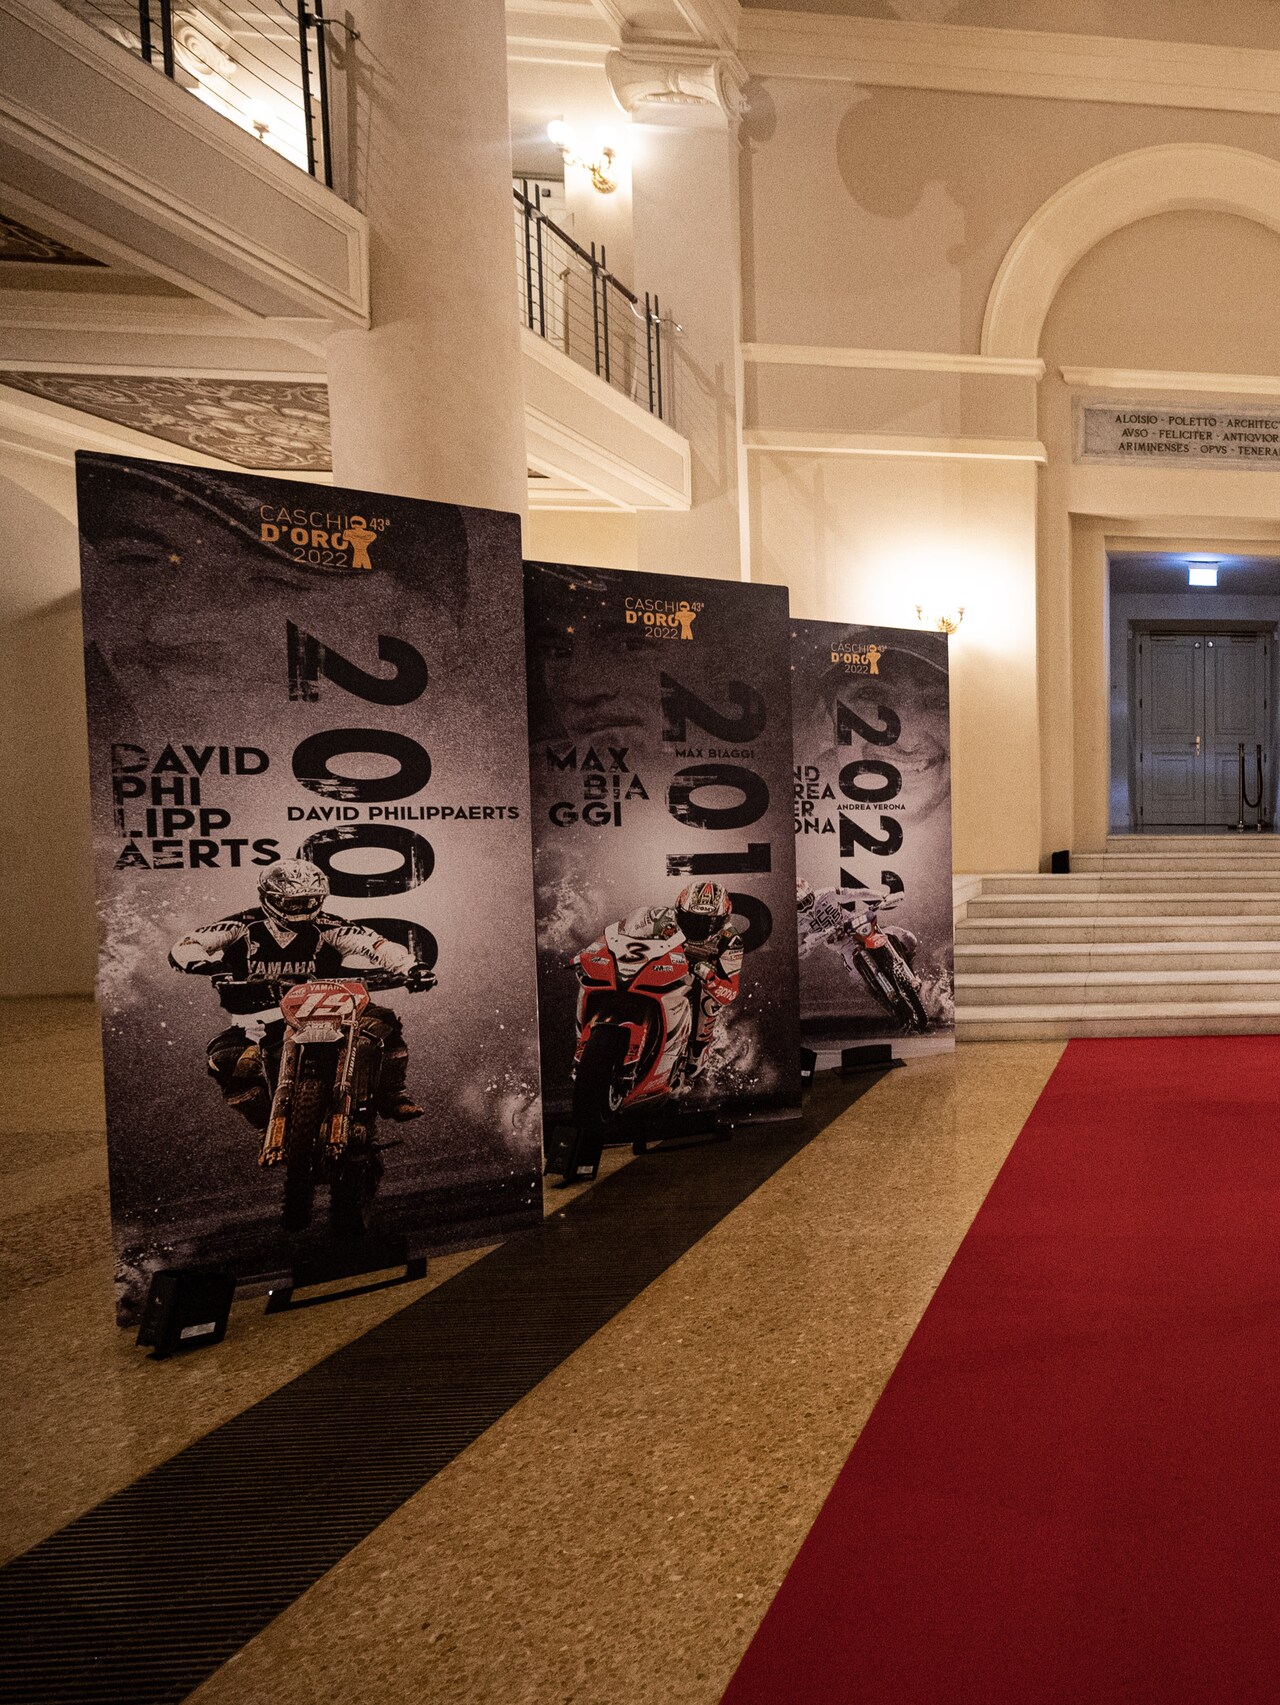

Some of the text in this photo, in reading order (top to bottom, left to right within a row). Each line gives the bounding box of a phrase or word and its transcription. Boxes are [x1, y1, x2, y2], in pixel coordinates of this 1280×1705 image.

[1115, 414, 1158, 425] ALOISIO
[1168, 415, 1217, 427] POLETTO
[1121, 428, 1149, 438] AVSO
[1159, 429, 1213, 441] FELICITER
[1118, 441, 1190, 453] ARIMINENSES
[1200, 444, 1228, 455] OPVS
[261, 523, 349, 551] D'ORO
[292, 547, 348, 568] 2022
[625, 610, 679, 628] D'ORO
[644, 626, 679, 640] 2022
[844, 664, 869, 675] 2022
[111, 742, 270, 776] DAVID
[547, 746, 630, 773] MAX
[675, 748, 755, 759] MAX BIAGGI
[112, 776, 200, 806] PHI
[583, 773, 650, 800] BIA
[287, 805, 520, 822] DAVID PHILIPPAERTS
[549, 801, 622, 828] GGI
[837, 803, 906, 811] ANDREA VERONA
[113, 807, 231, 838] LIPP
[113, 838, 281, 870] AERTS
[617, 942, 652, 966] 3
[247, 960, 317, 975] YAMAHA
[294, 992, 366, 1018] 19
